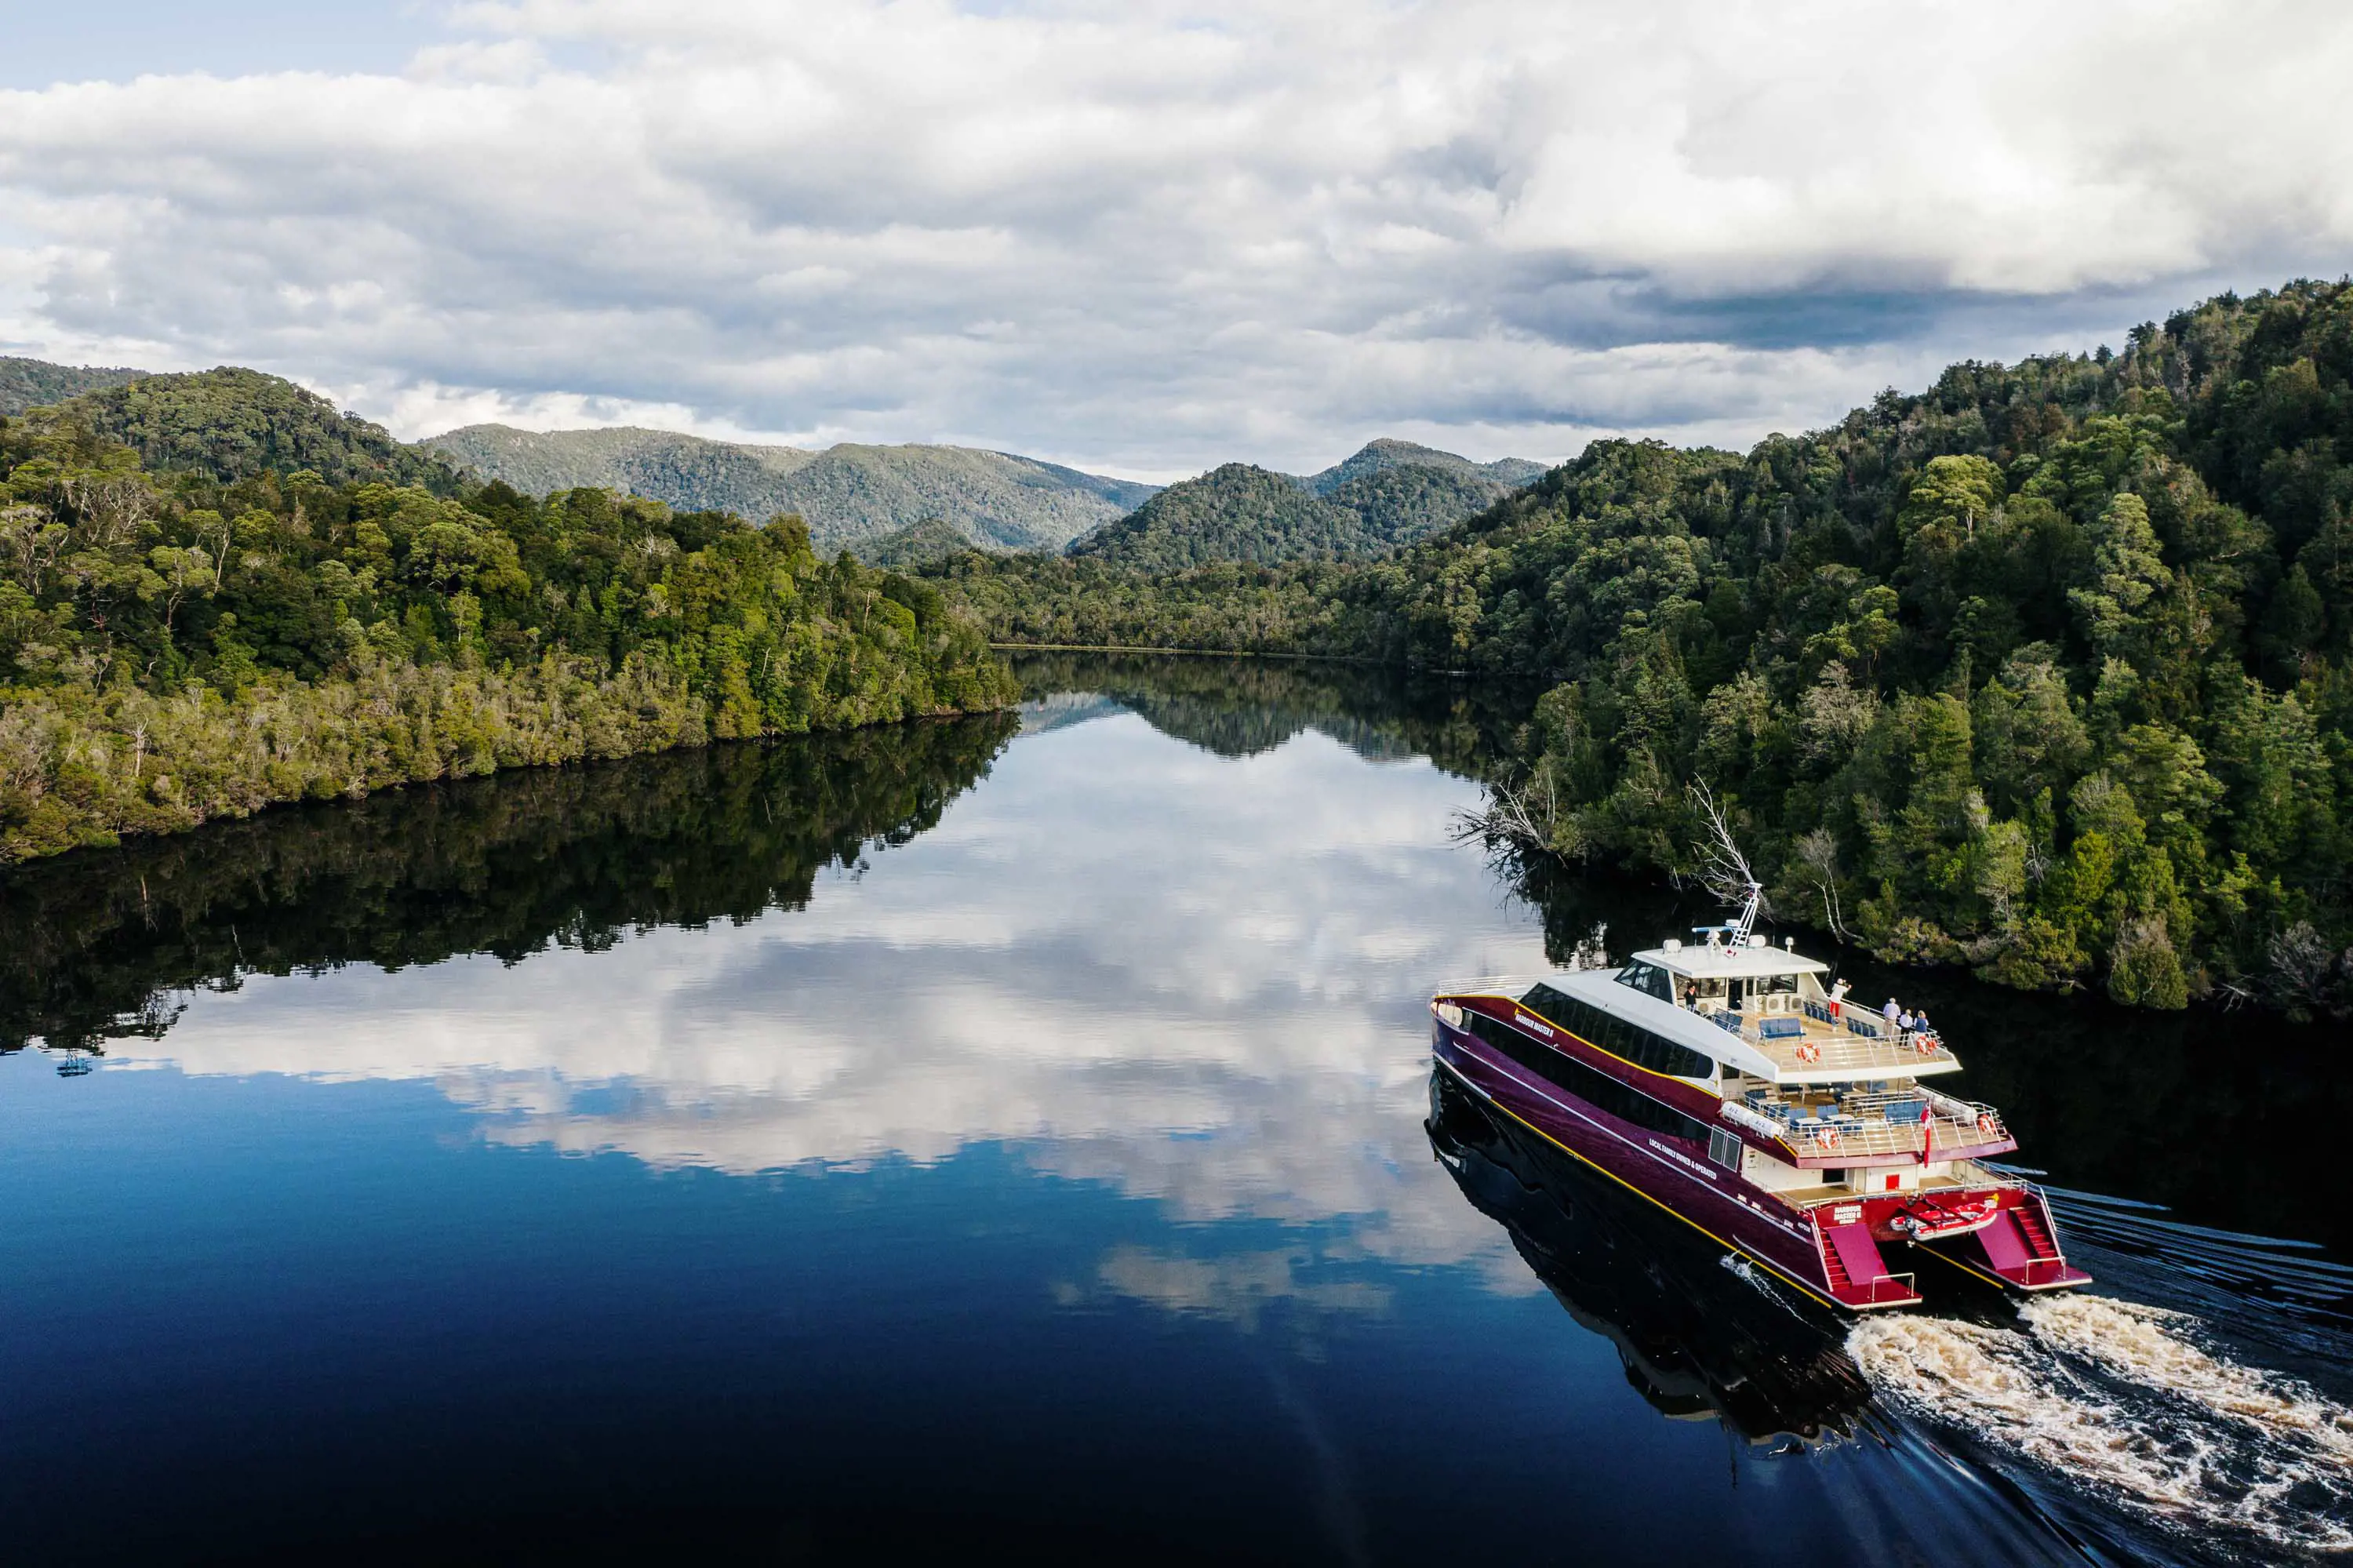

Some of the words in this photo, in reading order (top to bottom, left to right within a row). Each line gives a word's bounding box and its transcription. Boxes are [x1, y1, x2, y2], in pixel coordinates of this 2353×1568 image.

[1515, 1013, 1534, 1028] HARBOUR
[1533, 1021, 1551, 1036] MASTER
[1649, 1137, 1662, 1151] LOCAL
[1661, 1144, 1676, 1158] FAMILY
[1675, 1152, 1691, 1166] OWNED
[1691, 1160, 1695, 1169] &
[1695, 1162, 1717, 1181] OPERATED
[1834, 1212, 1856, 1221] MASTER
[1835, 1205, 1861, 1213] HARBOUR
